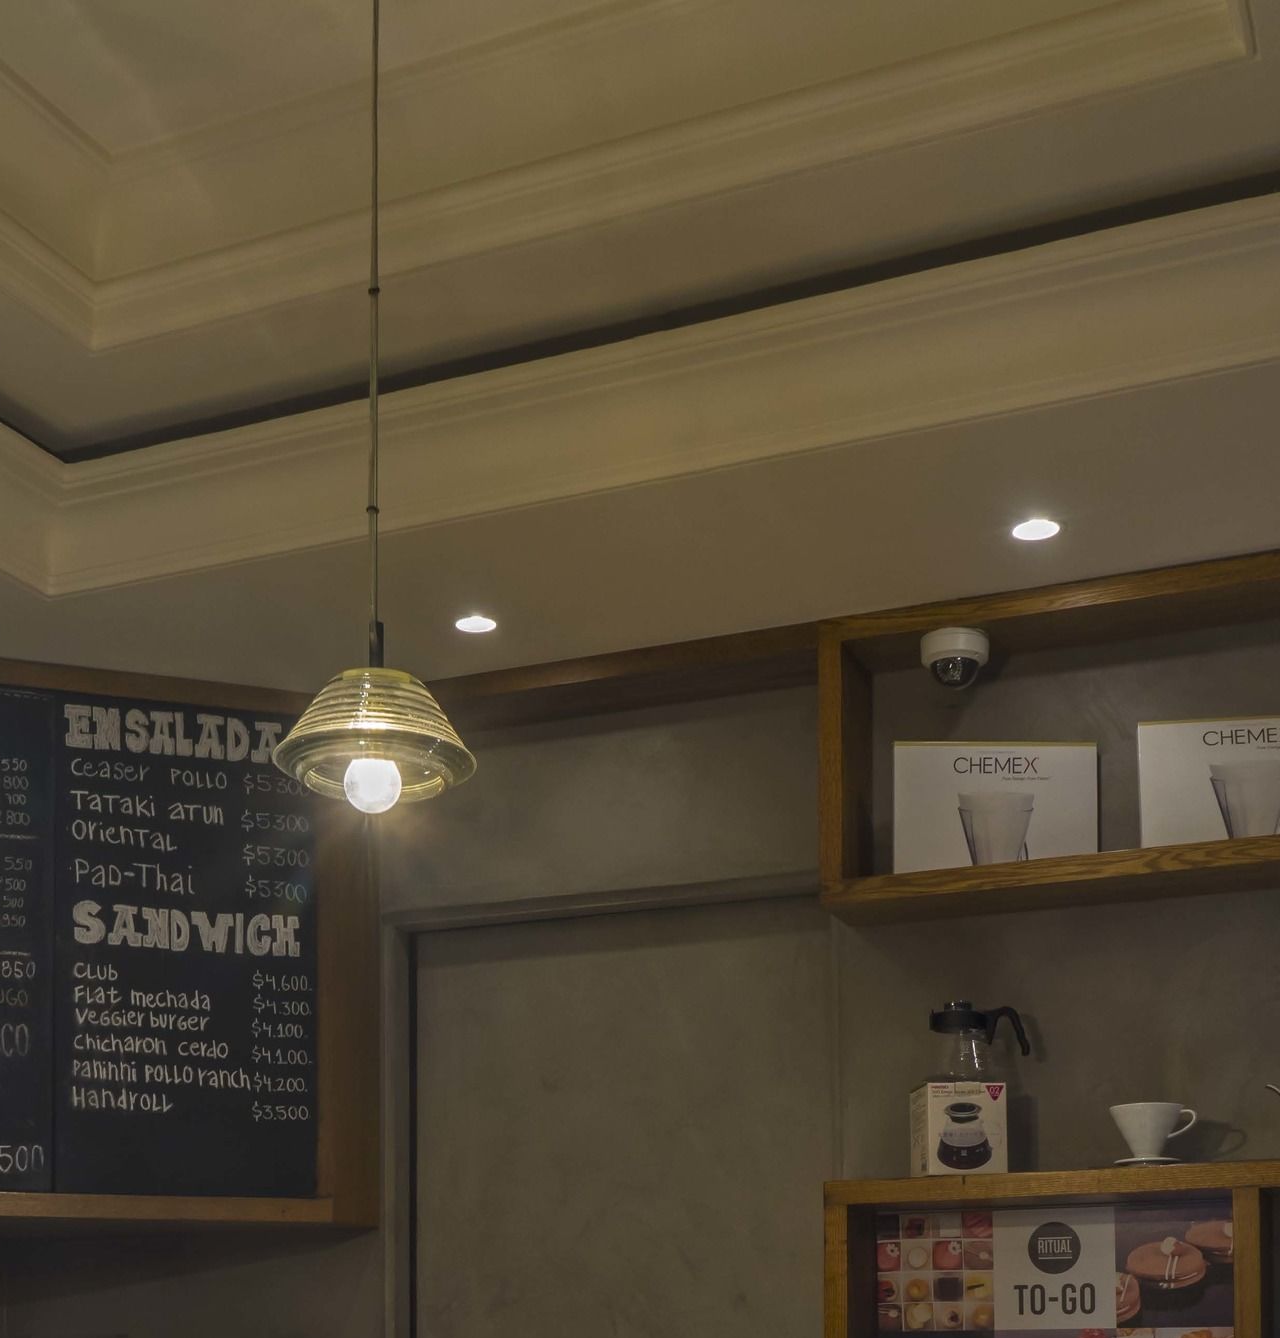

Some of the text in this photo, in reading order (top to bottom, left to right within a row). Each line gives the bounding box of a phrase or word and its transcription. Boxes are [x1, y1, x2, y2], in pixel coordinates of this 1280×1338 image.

[64, 703, 282, 764] ENSALADA
[953, 757, 1038, 774] CHEMEX
[72, 900, 301, 958] SANDWICH
[130, 989, 211, 1012] mechada
[178, 1039, 229, 1059] cerdo
[989, 1086, 999, 1096] 02
[1037, 1238, 1072, 1254] RITUAL
[1014, 1282, 1096, 1316] TO-GO
